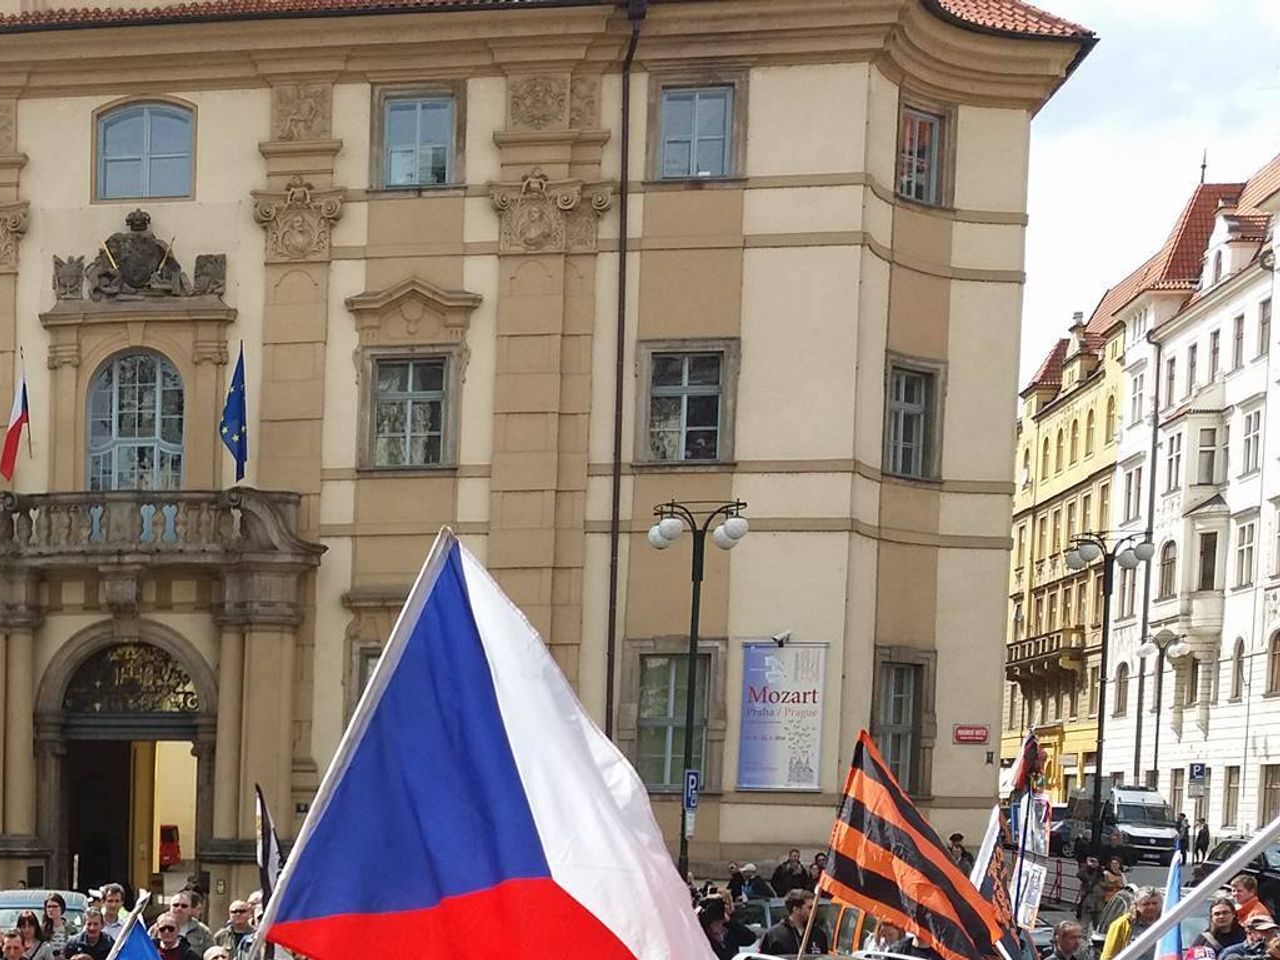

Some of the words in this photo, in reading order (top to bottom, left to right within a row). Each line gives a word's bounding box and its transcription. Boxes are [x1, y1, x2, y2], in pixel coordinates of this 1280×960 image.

[748, 686, 818, 704] Mozart
[785, 707, 818, 719] Prague
[1194, 765, 1201, 775] P
[689, 775, 697, 797] P
